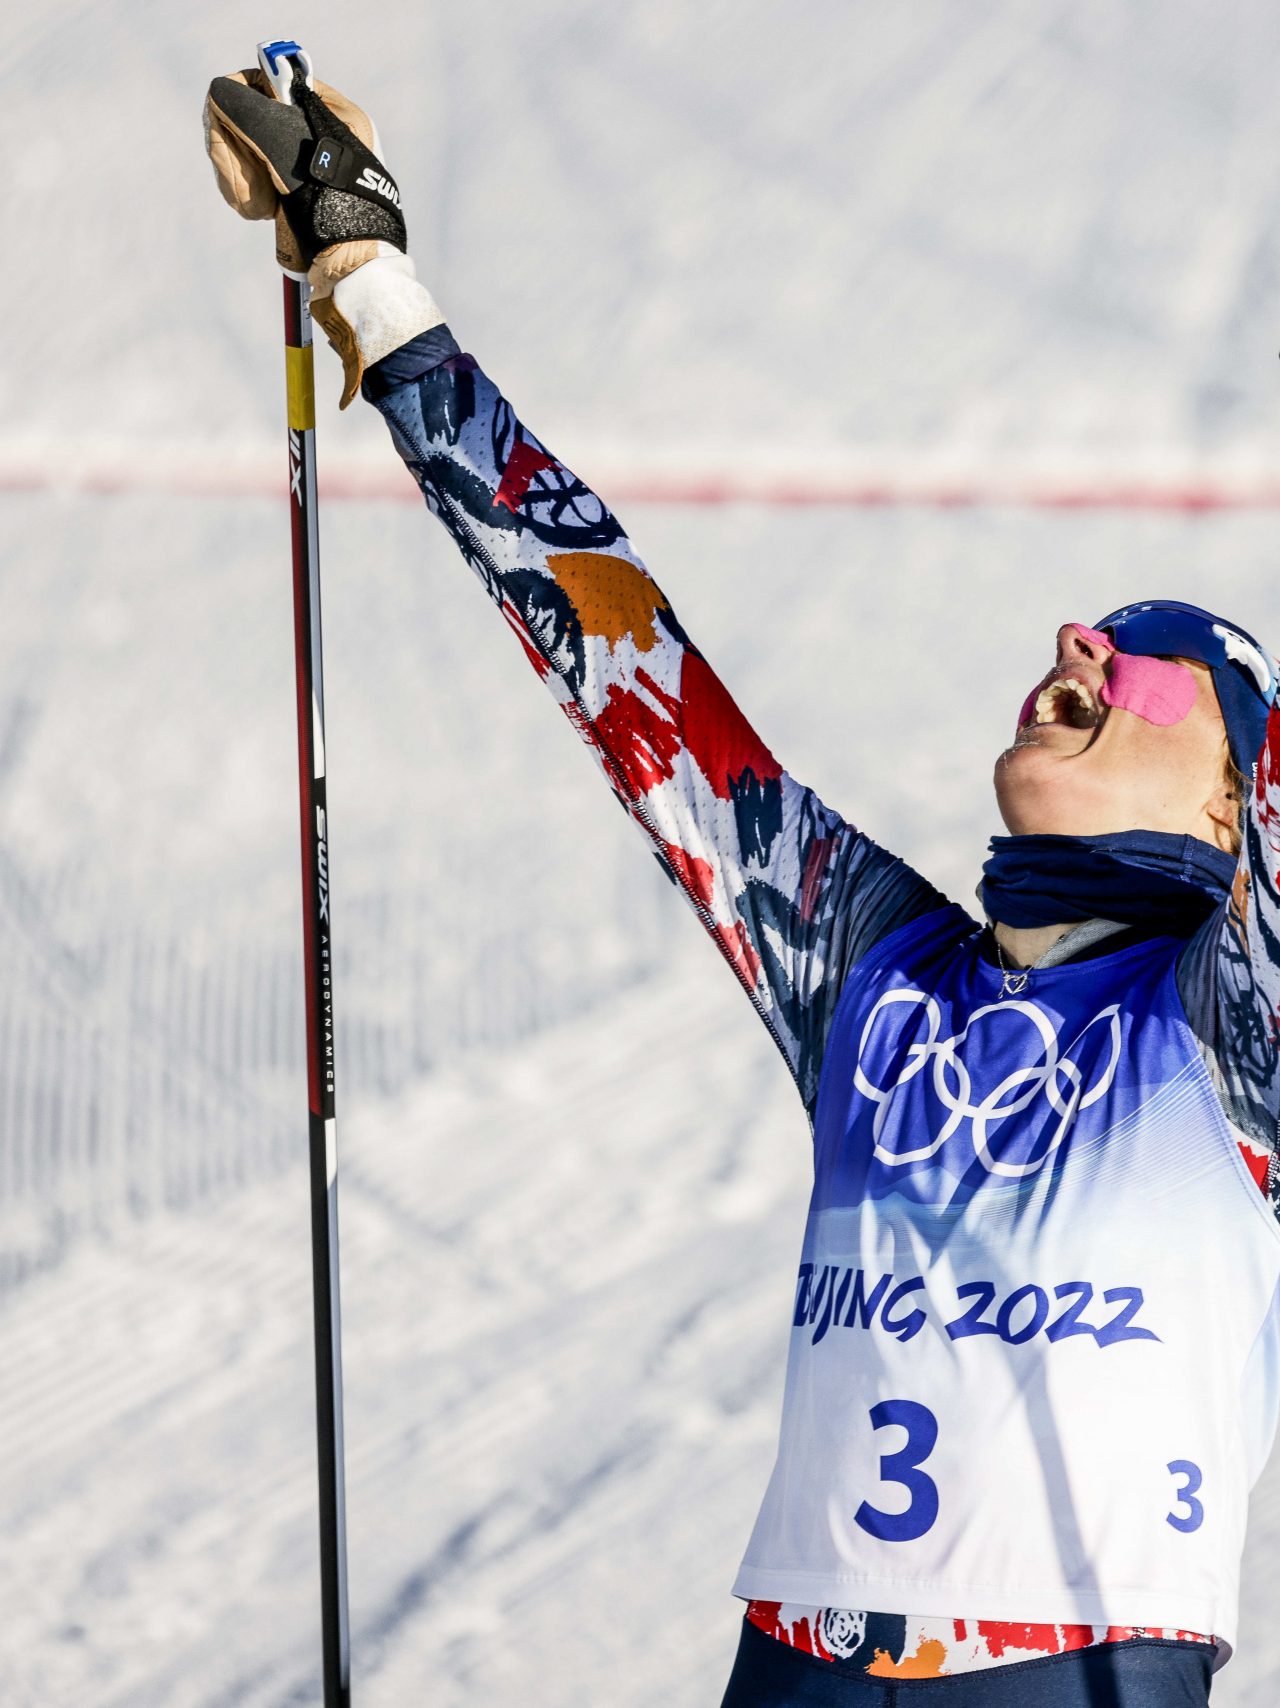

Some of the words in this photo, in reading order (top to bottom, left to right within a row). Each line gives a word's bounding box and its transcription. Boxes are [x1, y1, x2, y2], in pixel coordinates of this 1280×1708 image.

[319, 151, 331, 168] R
[315, 804, 329, 927] SWIX
[320, 935, 335, 1093] AERODYNAMICS
[945, 1281, 1164, 1348] 2022
[853, 1399, 939, 1542] 3
[1165, 1459, 1204, 1533] 3
